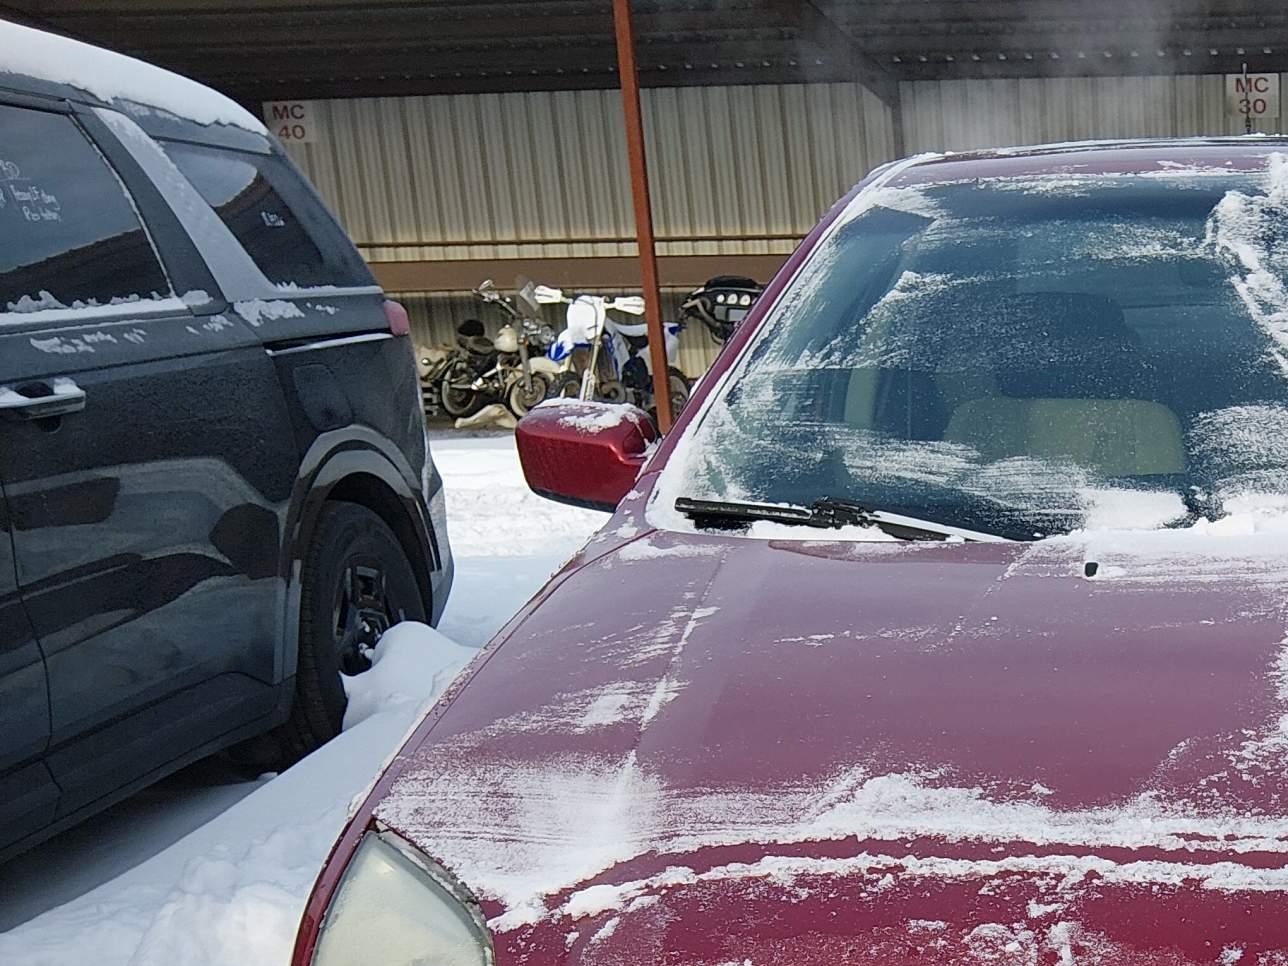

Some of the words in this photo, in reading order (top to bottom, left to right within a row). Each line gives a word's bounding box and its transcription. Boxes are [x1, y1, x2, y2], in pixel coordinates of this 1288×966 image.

[1235, 77, 1269, 93] MC
[272, 104, 305, 120] MC
[1239, 98, 1267, 114] 30
[279, 125, 305, 140] 40
